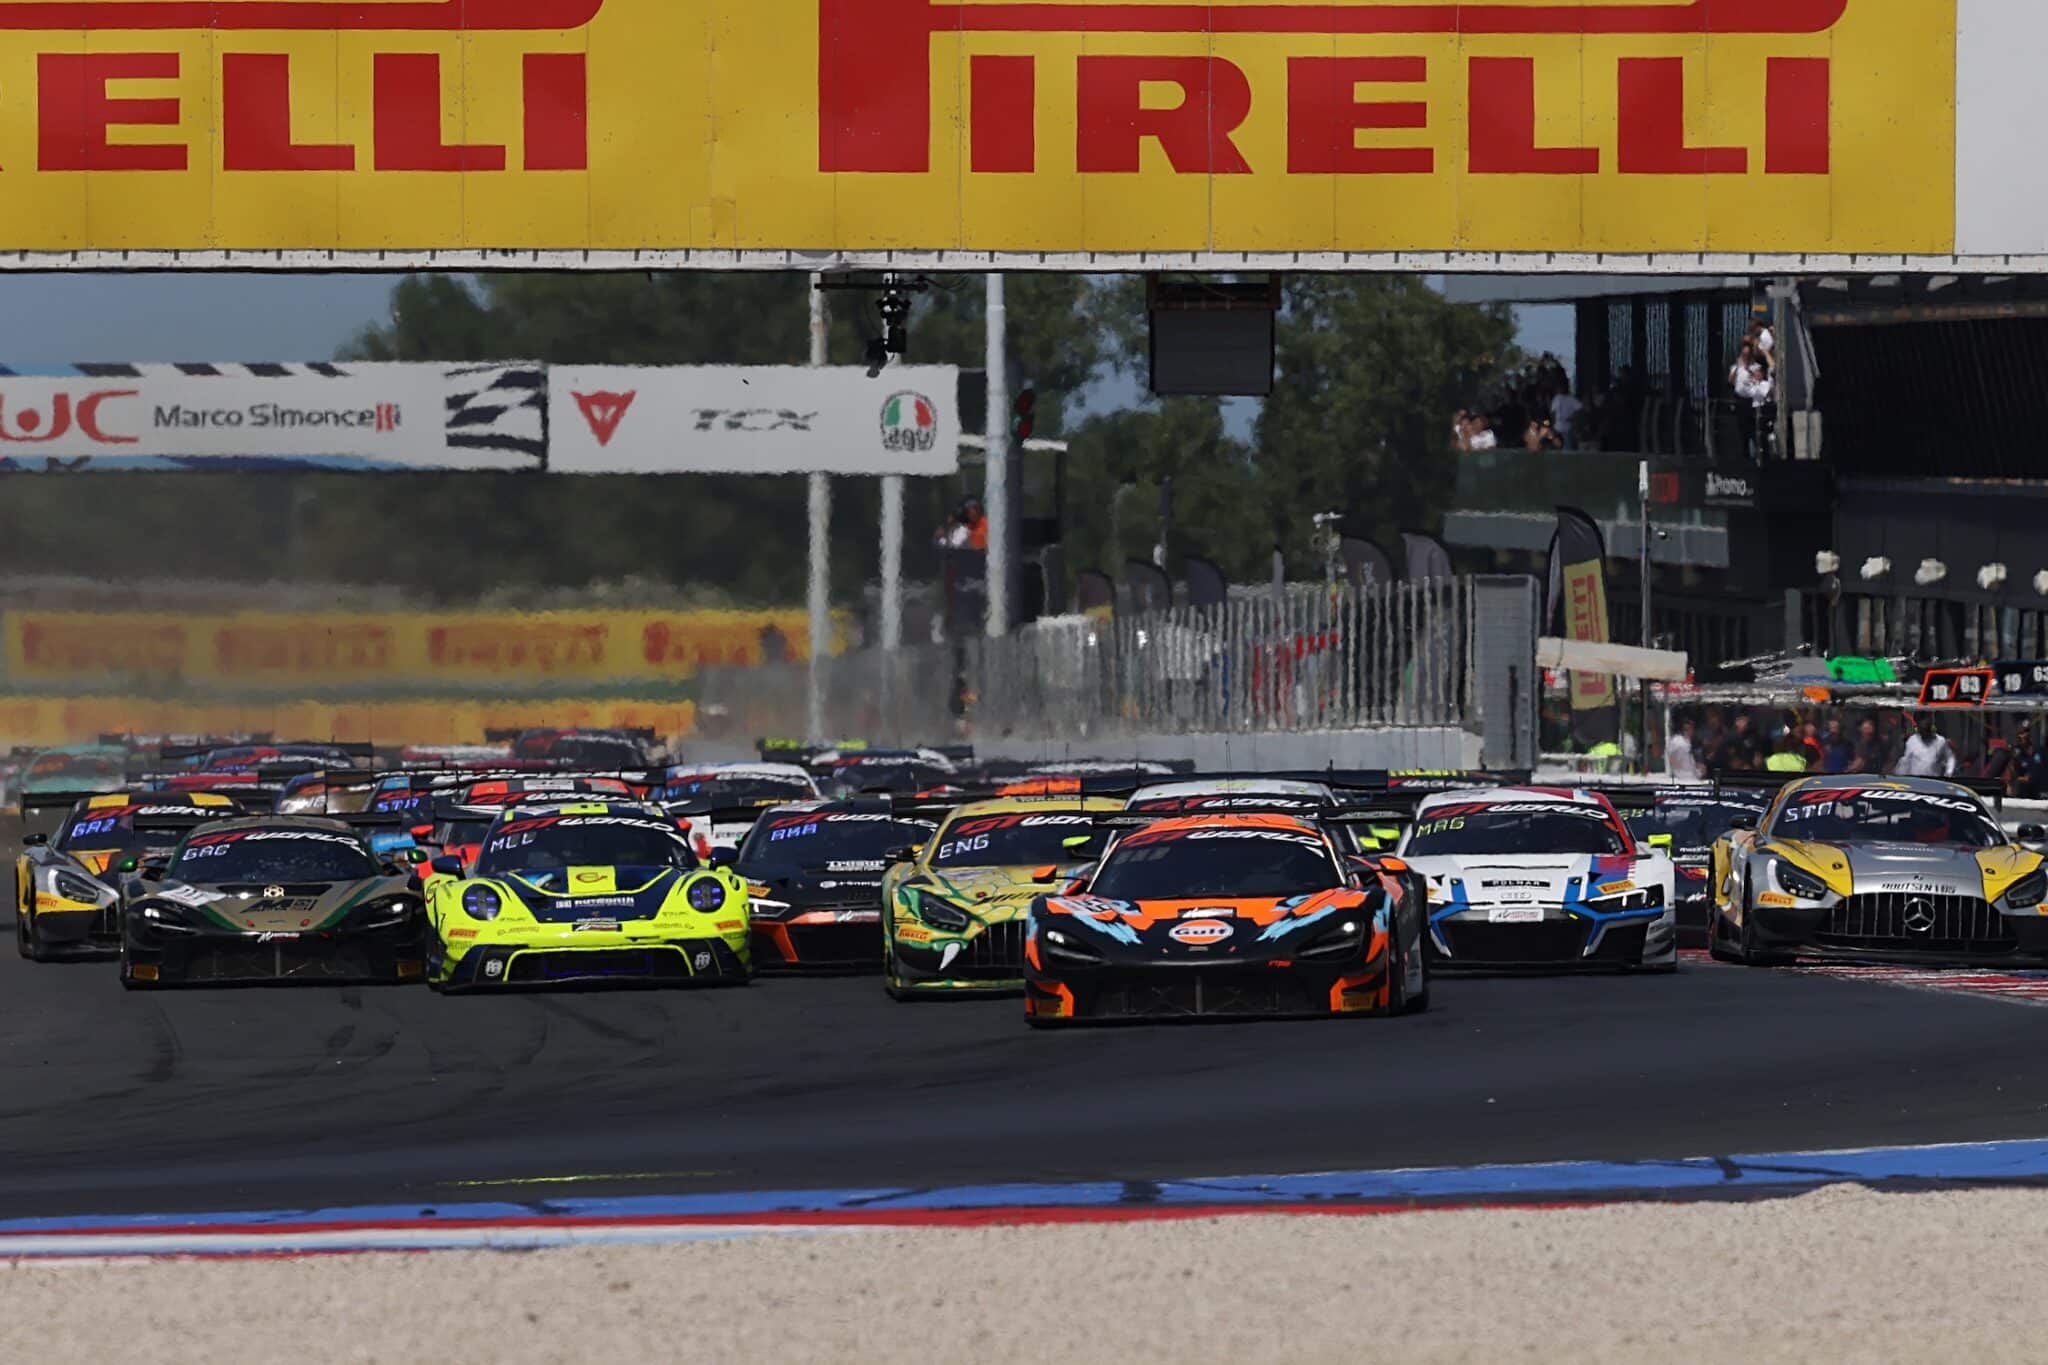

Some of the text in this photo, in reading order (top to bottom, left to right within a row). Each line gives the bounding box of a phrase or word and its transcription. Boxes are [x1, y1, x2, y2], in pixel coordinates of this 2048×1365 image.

[818, 0, 1846, 174] PIRELLI
[0, 53, 587, 171] ELLI
[153, 404, 243, 427] Marco
[248, 401, 402, 432] Simoncelli
[1860, 790, 1978, 812] WORLD
[1487, 803, 1609, 819] WORLD
[557, 817, 676, 832] WORLD
[1019, 815, 1093, 827] WOR
[1416, 817, 1465, 838] MAG
[244, 832, 360, 846] WORLD
[938, 833, 990, 860] ENG
[1186, 830, 1324, 846] WORLD
[899, 929, 929, 940] PIRELLI
